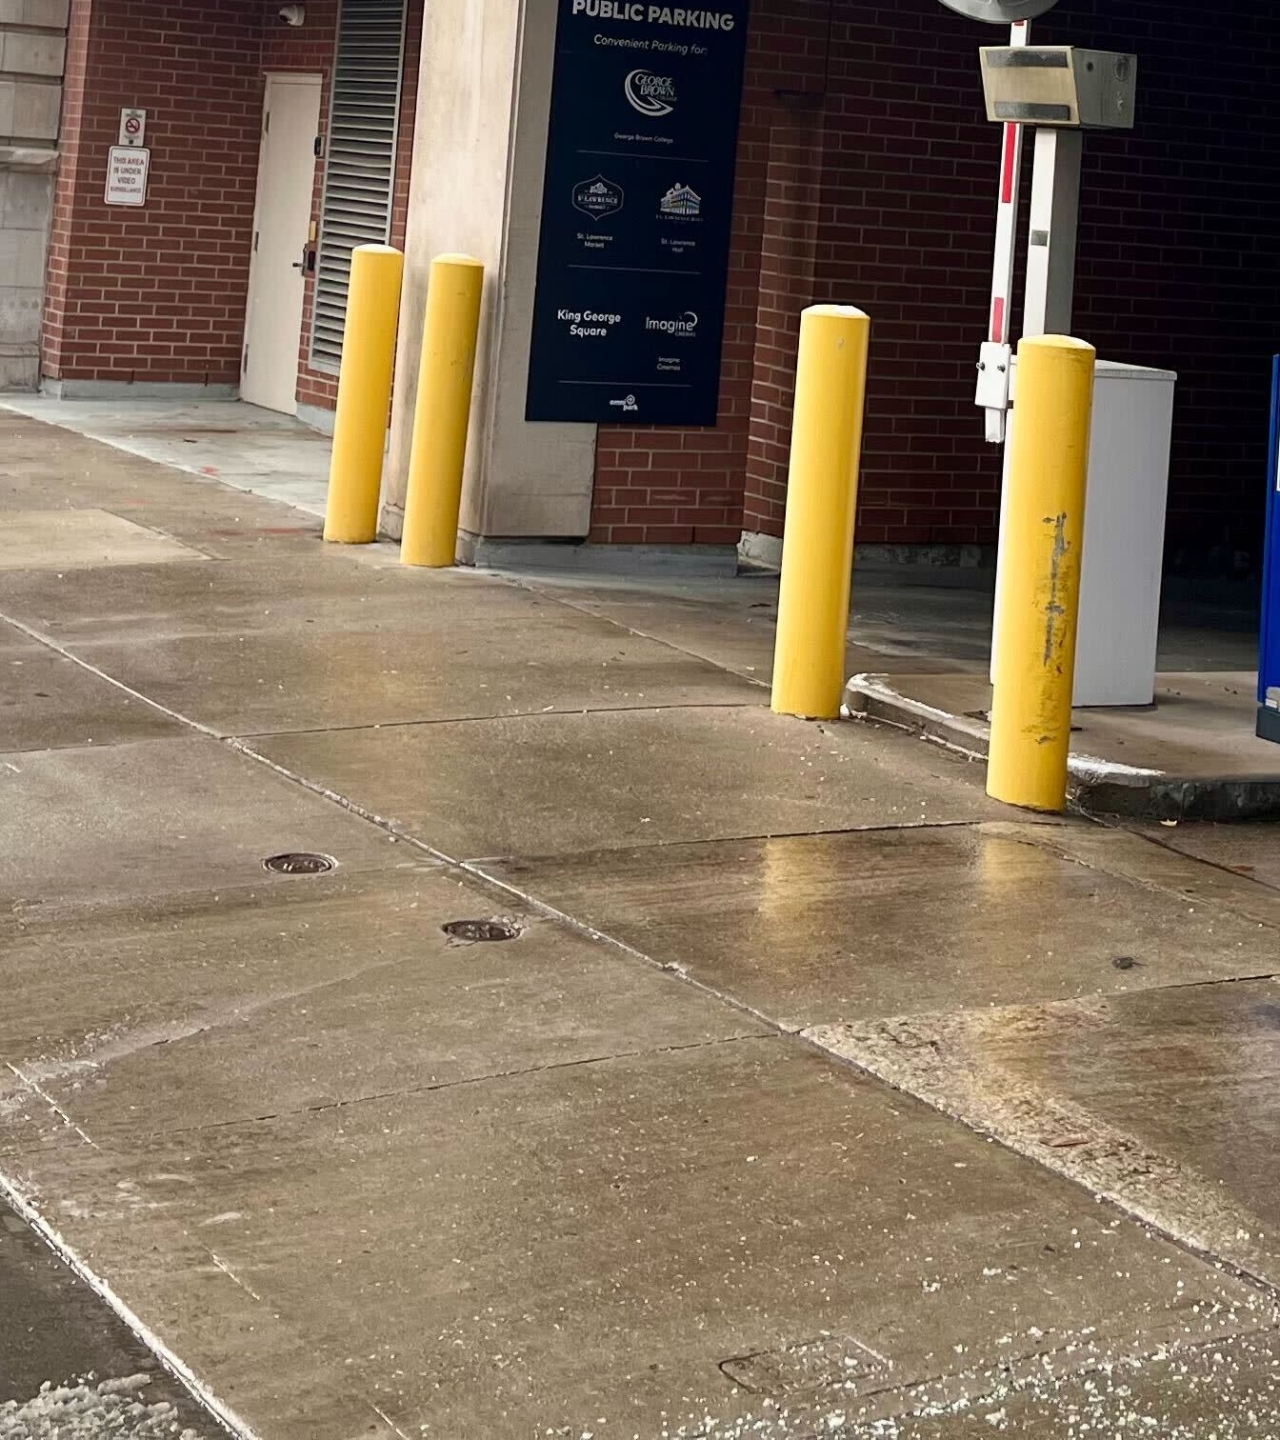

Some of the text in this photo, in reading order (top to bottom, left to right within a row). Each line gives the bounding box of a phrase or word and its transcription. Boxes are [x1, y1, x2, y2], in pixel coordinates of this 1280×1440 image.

[647, 5, 735, 31] PARKING
[594, 34, 708, 56] Convenient Parking for:
[635, 73, 673, 87] GEORGE
[640, 85, 675, 96] BROWN
[114, 156, 145, 166] THIS AREA
[120, 167, 142, 175] UNDER
[117, 176, 136, 185] VIDEO
[557, 309, 621, 325] King George
[645, 313, 696, 333] Imagine
[570, 325, 607, 338] Square
